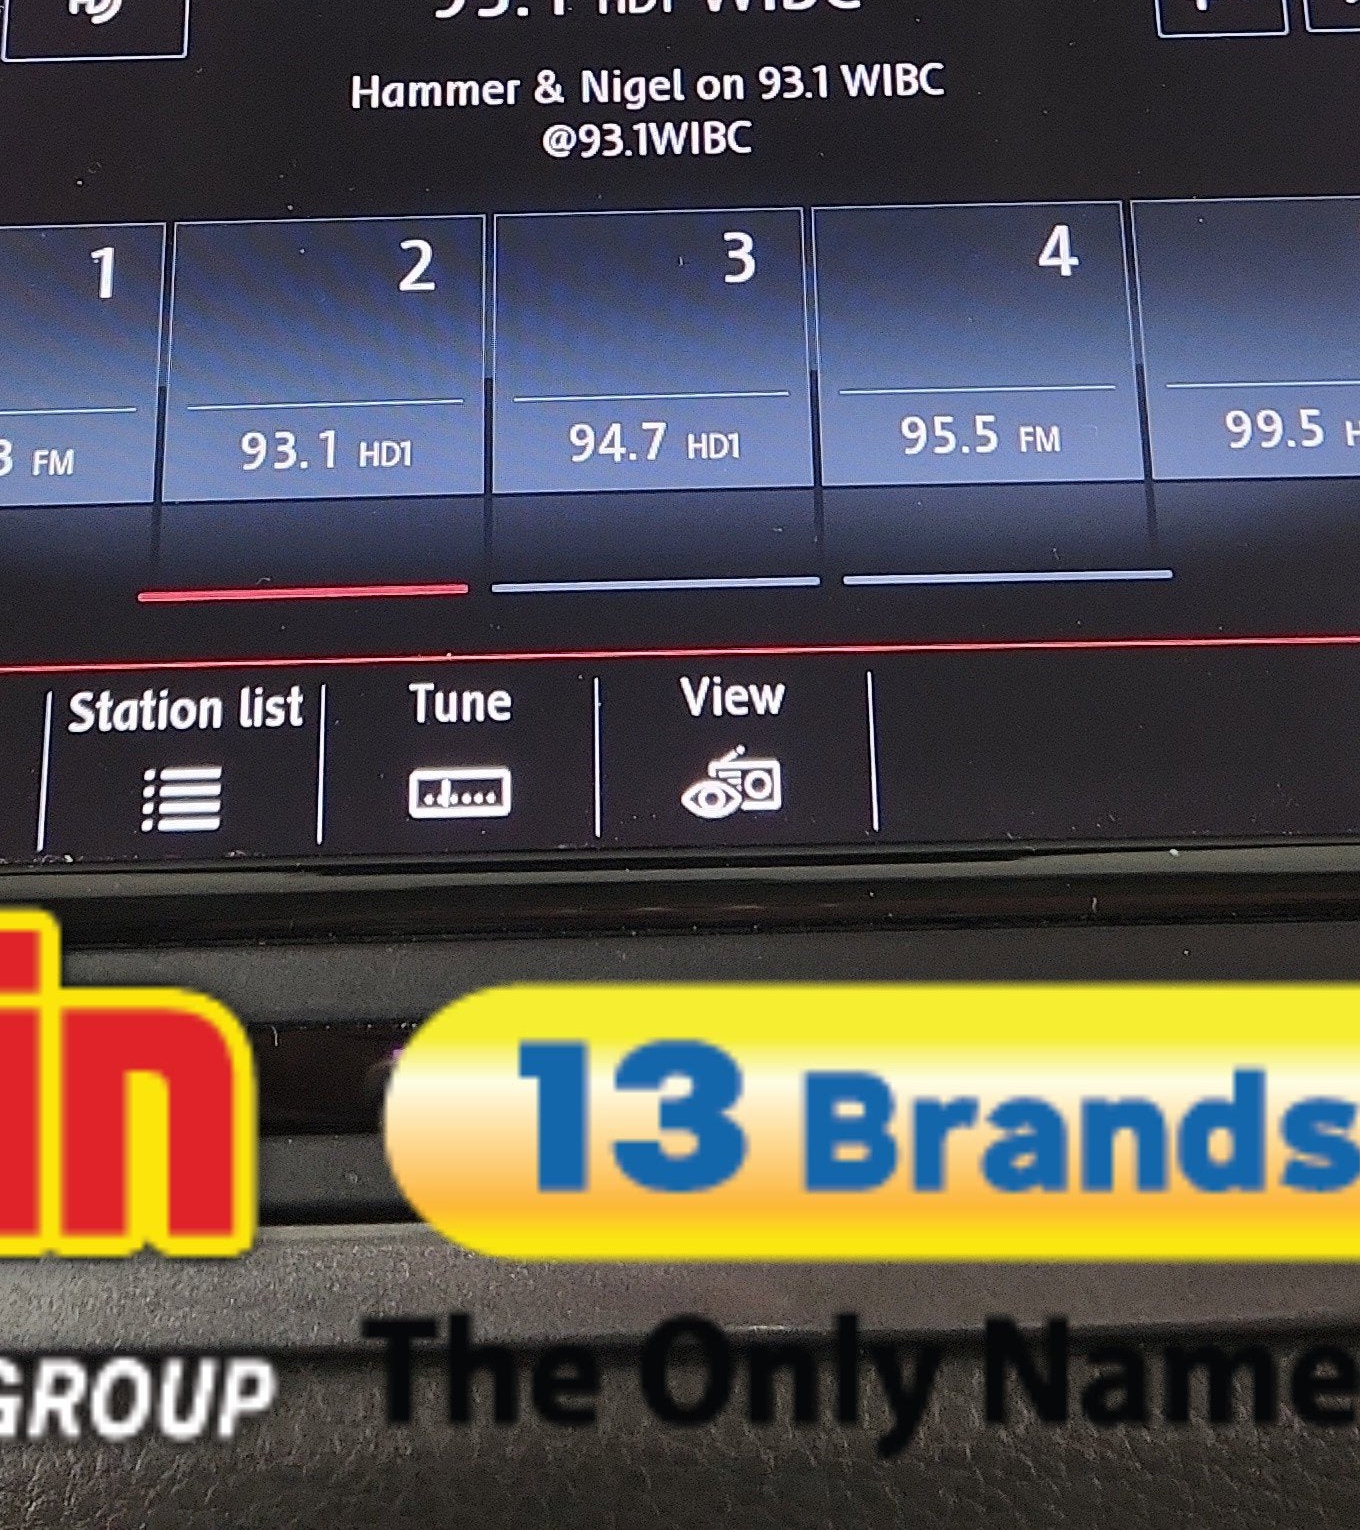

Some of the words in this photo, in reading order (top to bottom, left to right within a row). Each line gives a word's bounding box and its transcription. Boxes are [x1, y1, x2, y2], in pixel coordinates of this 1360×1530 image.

[352, 74, 521, 109] Hammer
[534, 69, 565, 104] &
[581, 68, 685, 110] Nigel
[696, 74, 744, 101] on
[758, 64, 828, 100] 93.1
[839, 62, 945, 97] WIBC
[542, 120, 753, 159] @93.1WIBC
[399, 239, 435, 291] 2
[723, 232, 755, 283] 3
[1038, 225, 1079, 277] 4
[91, 247, 115, 299] 1
[569, 422, 667, 463] 94.7
[687, 432, 740, 460] HD1
[901, 415, 998, 455] 95.5
[1019, 425, 1061, 453] FM
[1225, 408, 1324, 449] 99.5
[32, 448, 75, 476] FM
[241, 430, 335, 471] 93.1
[359, 440, 411, 468] HD1
[68, 688, 222, 733] Station
[239, 685, 304, 728] list
[408, 682, 512, 723] Tune
[679, 675, 786, 717] View
